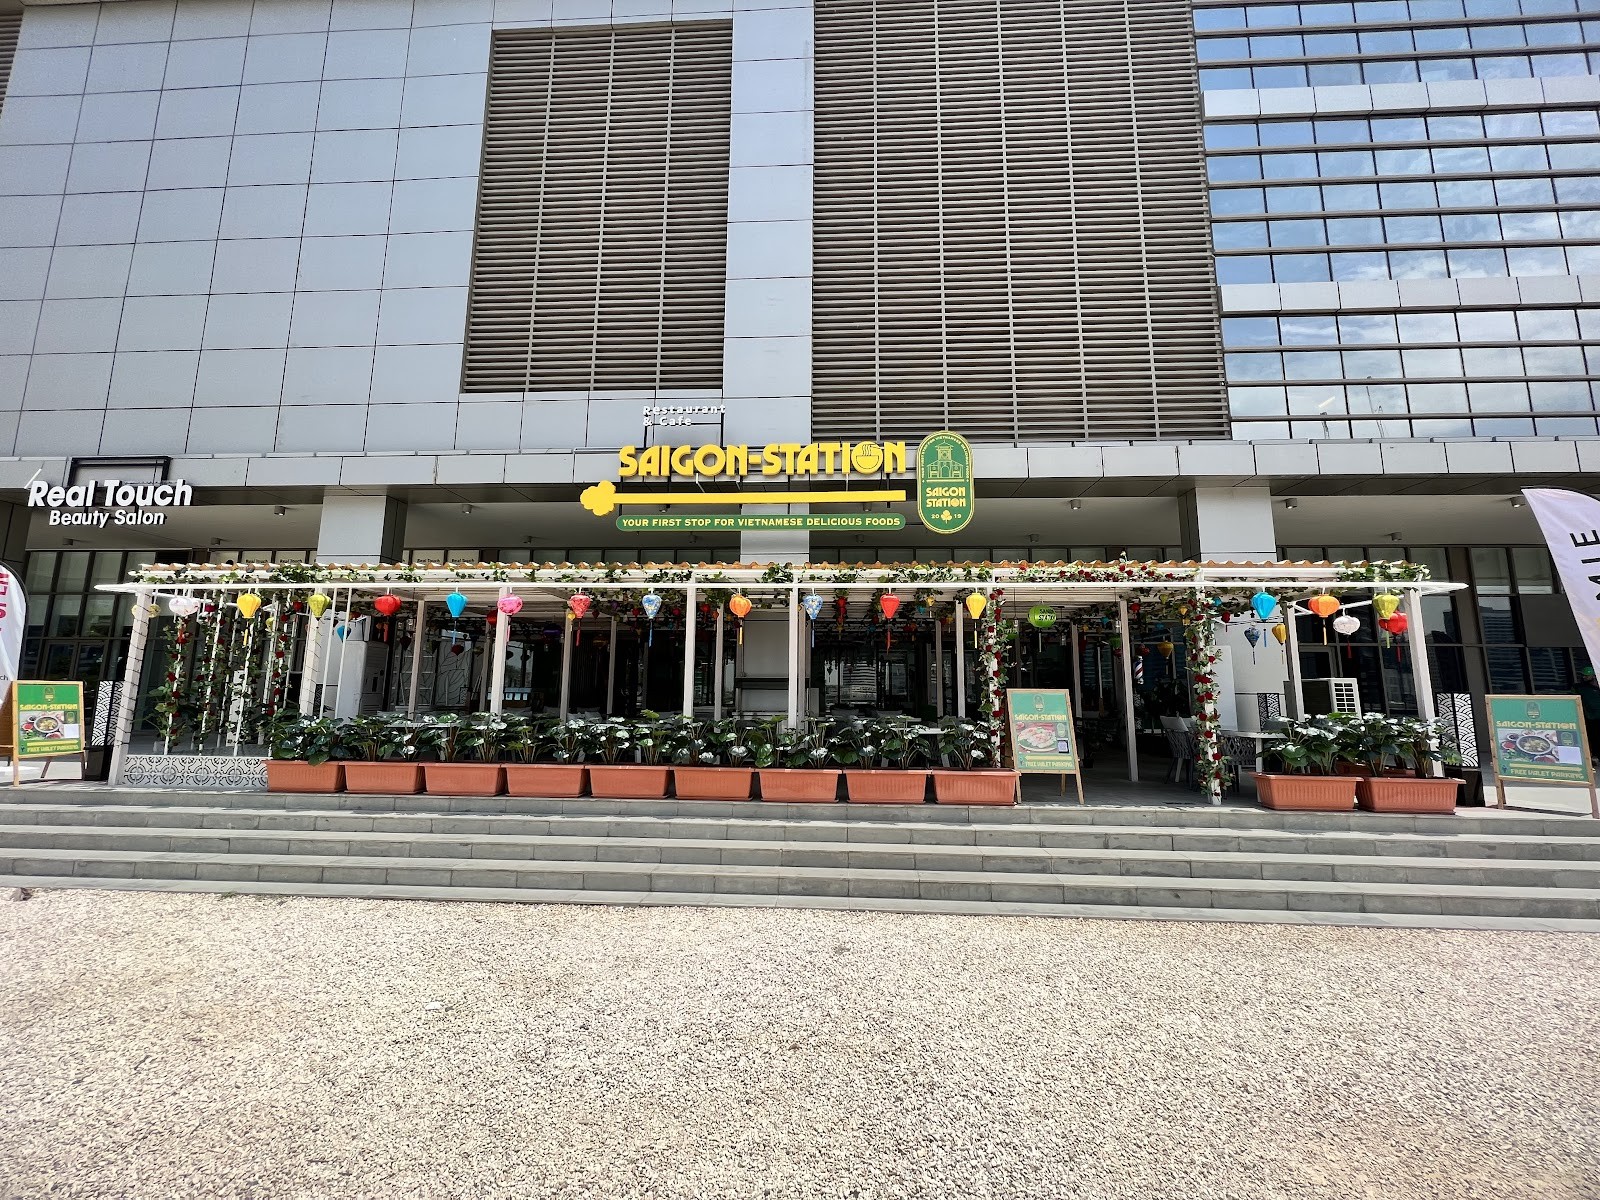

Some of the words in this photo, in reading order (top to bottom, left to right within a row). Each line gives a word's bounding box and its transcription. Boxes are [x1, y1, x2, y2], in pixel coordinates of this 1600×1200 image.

[642, 404, 726, 416] Restaurant
[642, 416, 652, 426] &
[659, 416, 692, 426] Cafe
[618, 442, 906, 476] SAIGON-STATION
[28, 480, 96, 506] Real
[104, 478, 192, 506] Touch
[926, 486, 966, 496] SAIGON
[926, 498, 966, 508] STATION
[49, 510, 110, 528] Beauty
[114, 509, 165, 525] Salon
[1496, 720, 1576, 729] SAIGON-STATION
